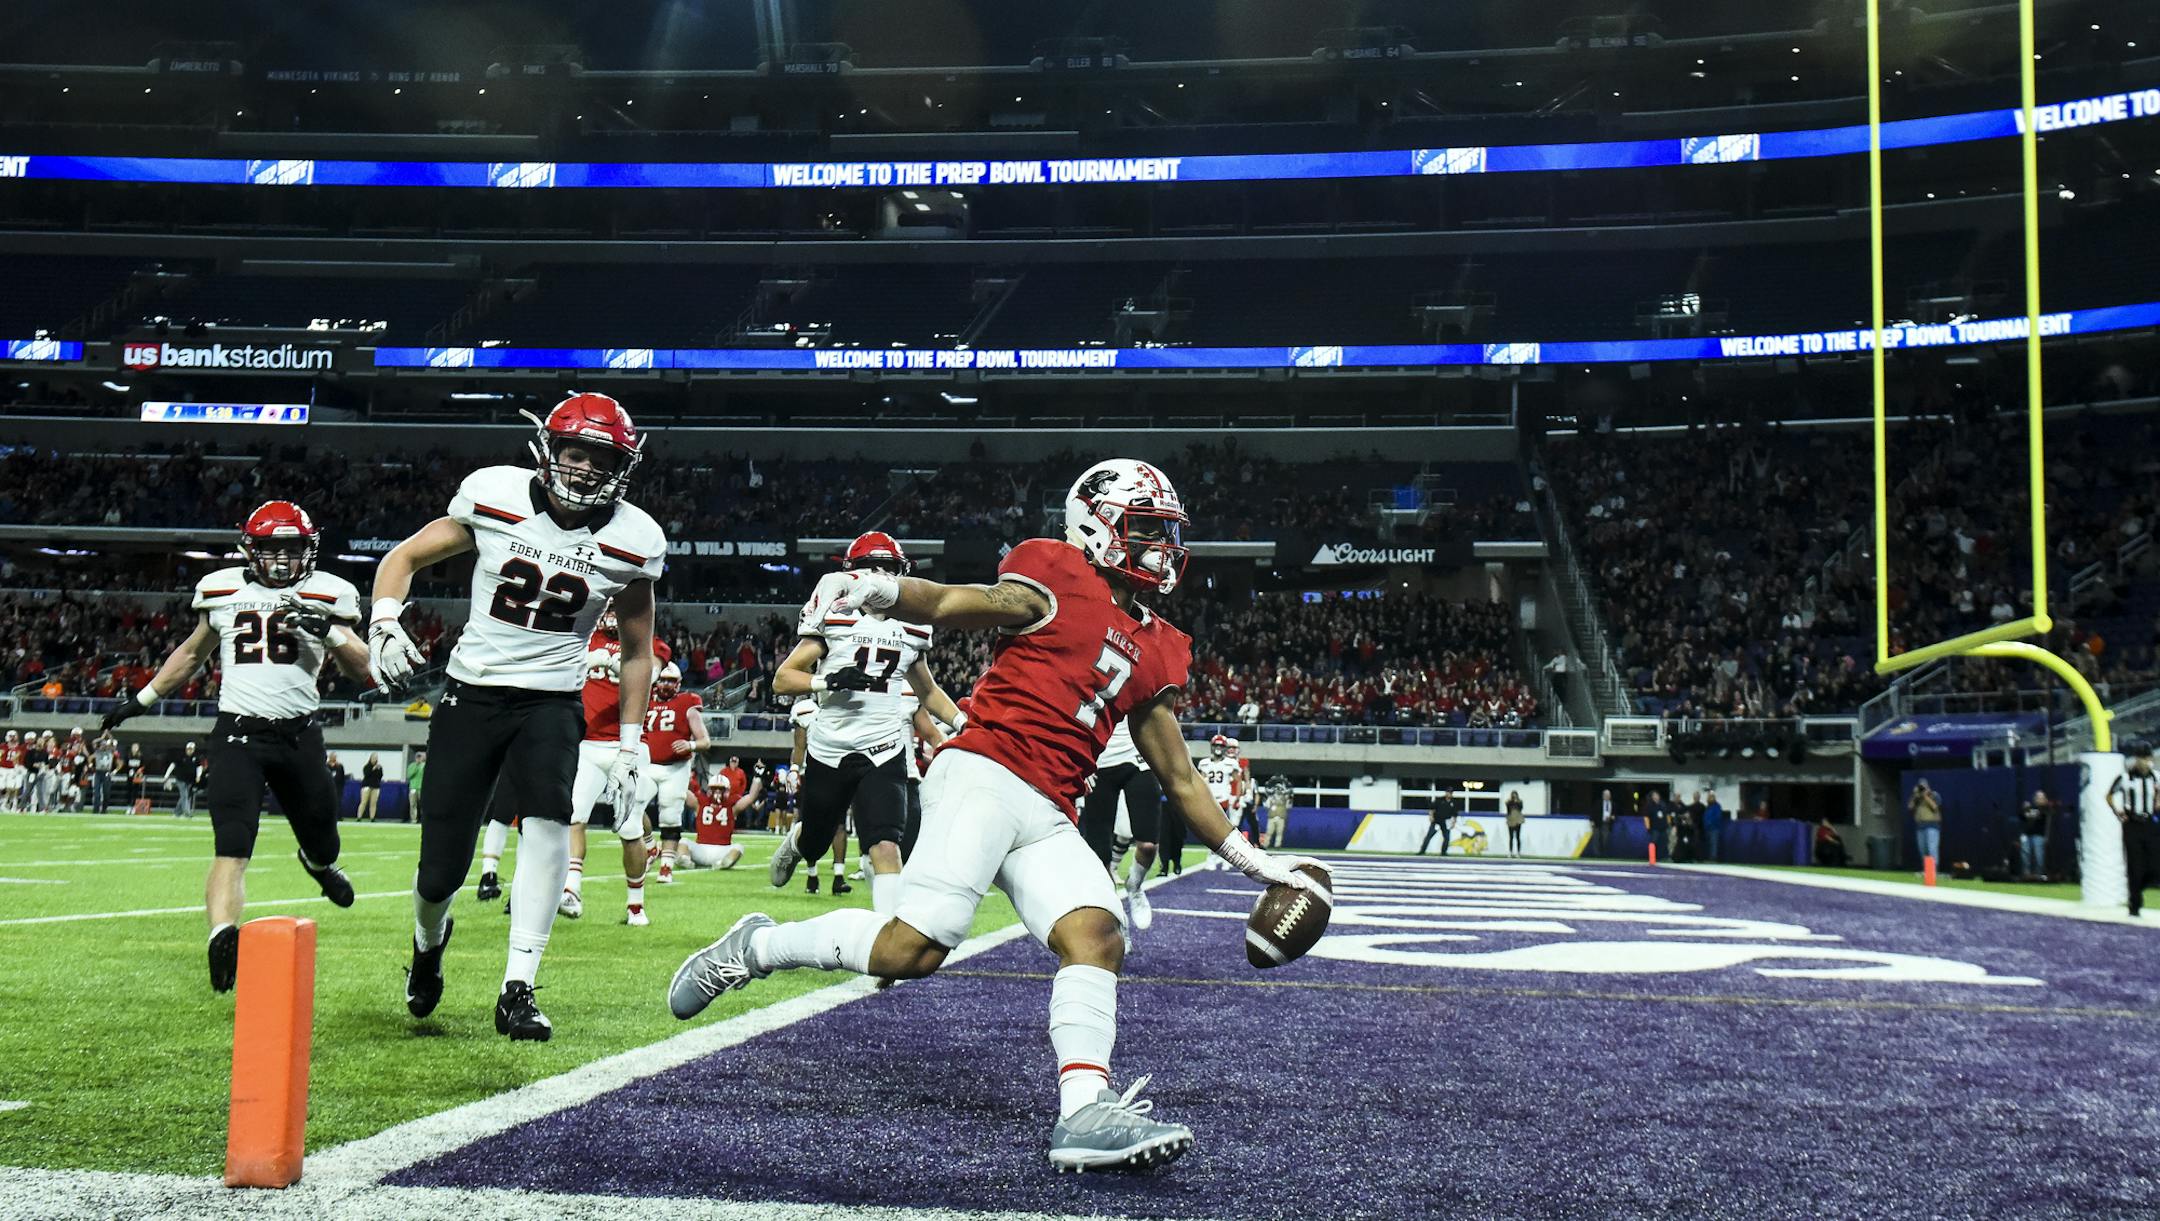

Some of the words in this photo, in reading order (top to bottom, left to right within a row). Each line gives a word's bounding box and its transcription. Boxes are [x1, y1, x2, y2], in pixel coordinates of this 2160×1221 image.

[784, 63, 823, 73] MARSHALL
[826, 63, 838, 72] 70
[1067, 58, 1090, 68] ELLER
[266, 71, 319, 81] MINNESOTA
[323, 71, 360, 81] VIKINGS
[388, 72, 410, 82] RING
[2014, 94, 2128, 134] WELCOME
[2129, 89, 2160, 117] TO
[773, 163, 864, 185] WELCOME
[866, 164, 892, 184] TO
[894, 163, 932, 184] THE
[935, 162, 986, 183] PREP
[989, 161, 1046, 183] BOWL
[1047, 159, 1181, 182] TOURNAMENT
[1721, 335, 1799, 357] WELCOME
[1801, 333, 1822, 352] TO
[1824, 331, 1857, 351] THE
[1906, 324, 1956, 347] BOWL
[1957, 314, 2072, 342] TOURNAENT
[813, 350, 883, 368] WELCOME
[884, 350, 904, 367] TO
[905, 350, 934, 367] THE
[936, 350, 974, 368] PREP
[975, 350, 1018, 368] BOWL
[1019, 350, 1117, 367] TOURNAMENT
[290, 409, 300, 420] 0
[348, 536, 402, 551] verizo
[694, 541, 735, 556] WILD
[737, 541, 787, 557] WINGS
[1333, 542, 1387, 564] Coors
[1388, 549, 1436, 563] LIGHT
[509, 541, 543, 560] EDEN
[547, 553, 598, 576] PRAIRIE
[489, 557, 590, 632] 22
[233, 602, 256, 611] EDEN
[233, 611, 299, 664] 26
[852, 635, 873, 645] EDEN
[877, 638, 906, 650] PRAIRIE
[1106, 626, 1142, 664] NORTH
[854, 646, 901, 693] 17
[1074, 644, 1133, 729] 7
[647, 709, 676, 732] 72
[1208, 771, 1224, 784] 23
[702, 806, 728, 826] 64
